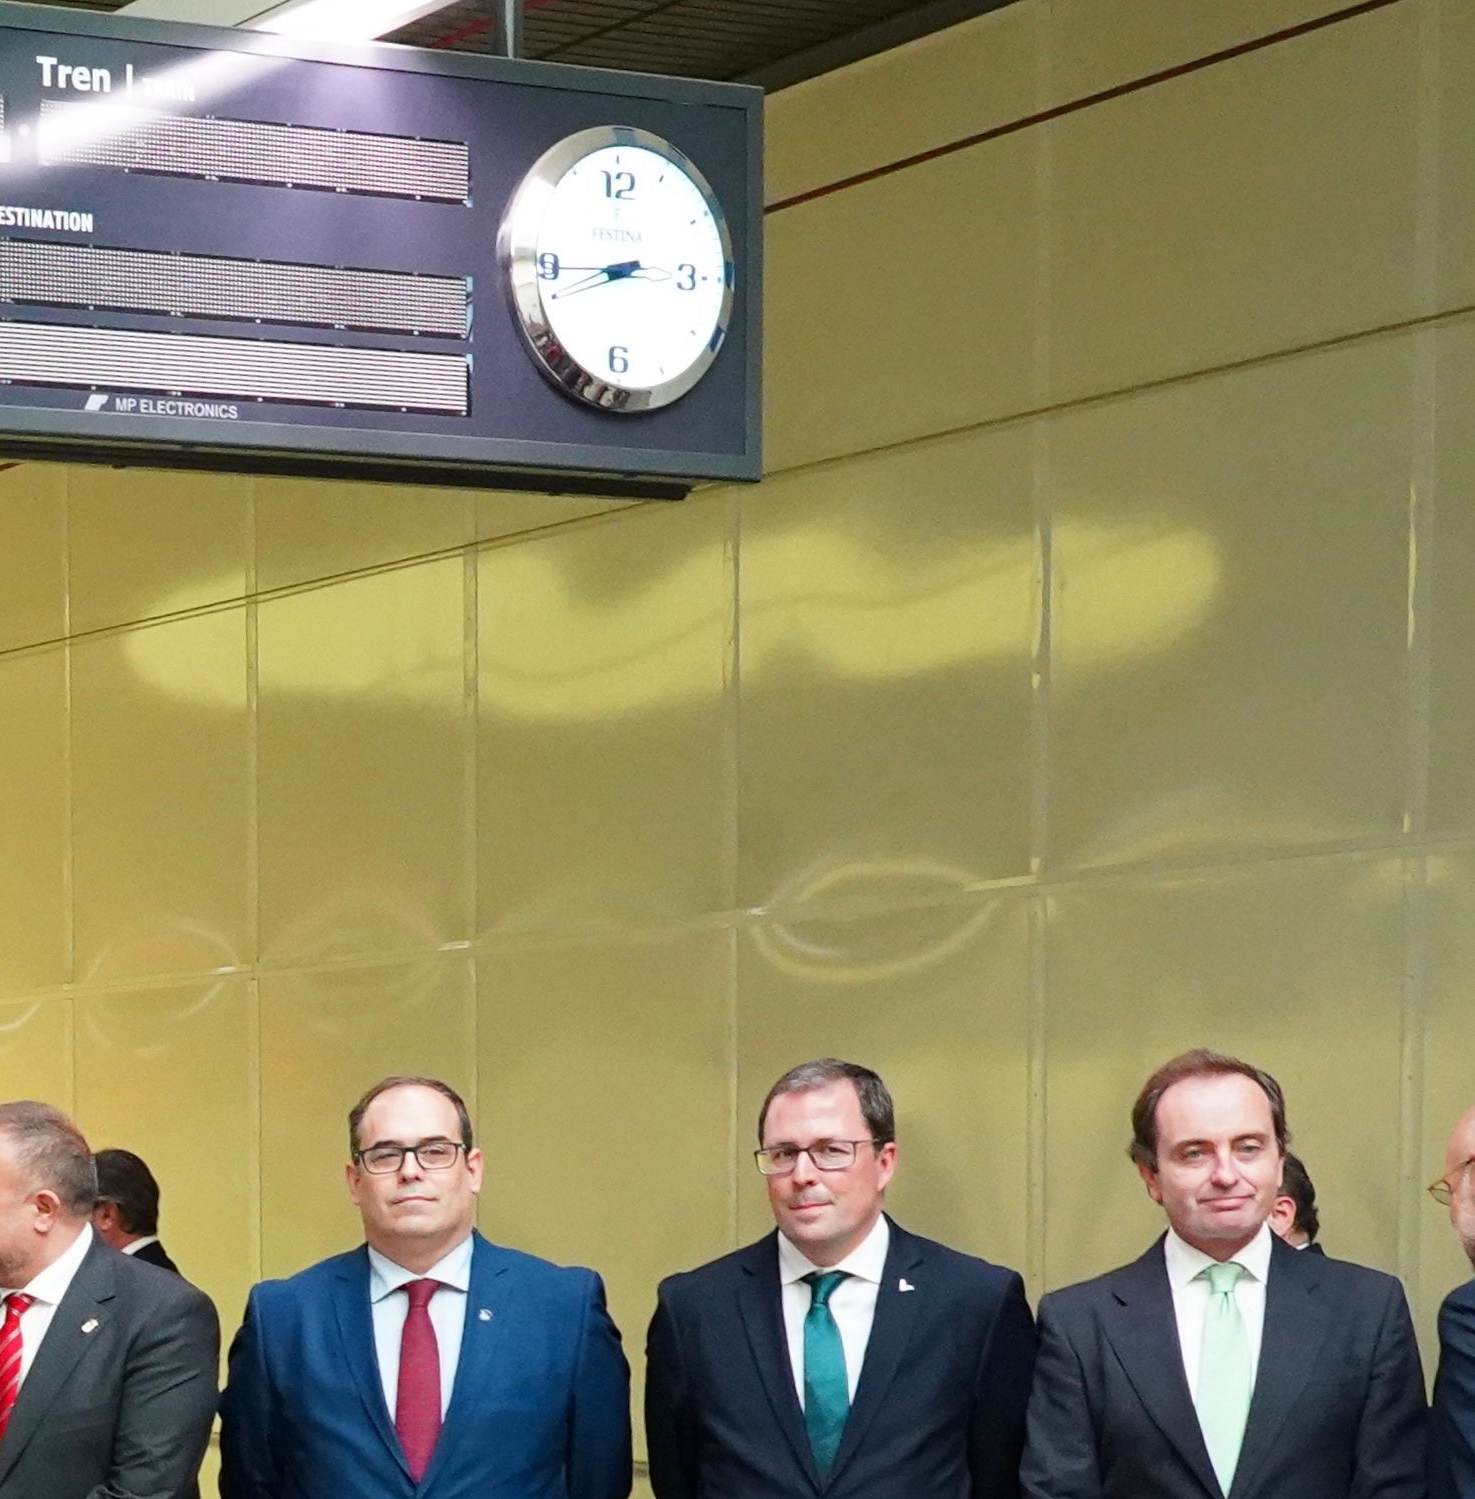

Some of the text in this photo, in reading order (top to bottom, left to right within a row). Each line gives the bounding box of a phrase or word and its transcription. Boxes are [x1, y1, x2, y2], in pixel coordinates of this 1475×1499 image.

[36, 55, 112, 93] Tren
[599, 169, 637, 201] 12
[591, 226, 644, 243] FESTINA
[676, 263, 697, 291] 3
[607, 345, 630, 374] 6
[115, 398, 239, 418] MP ELECTRONICS
